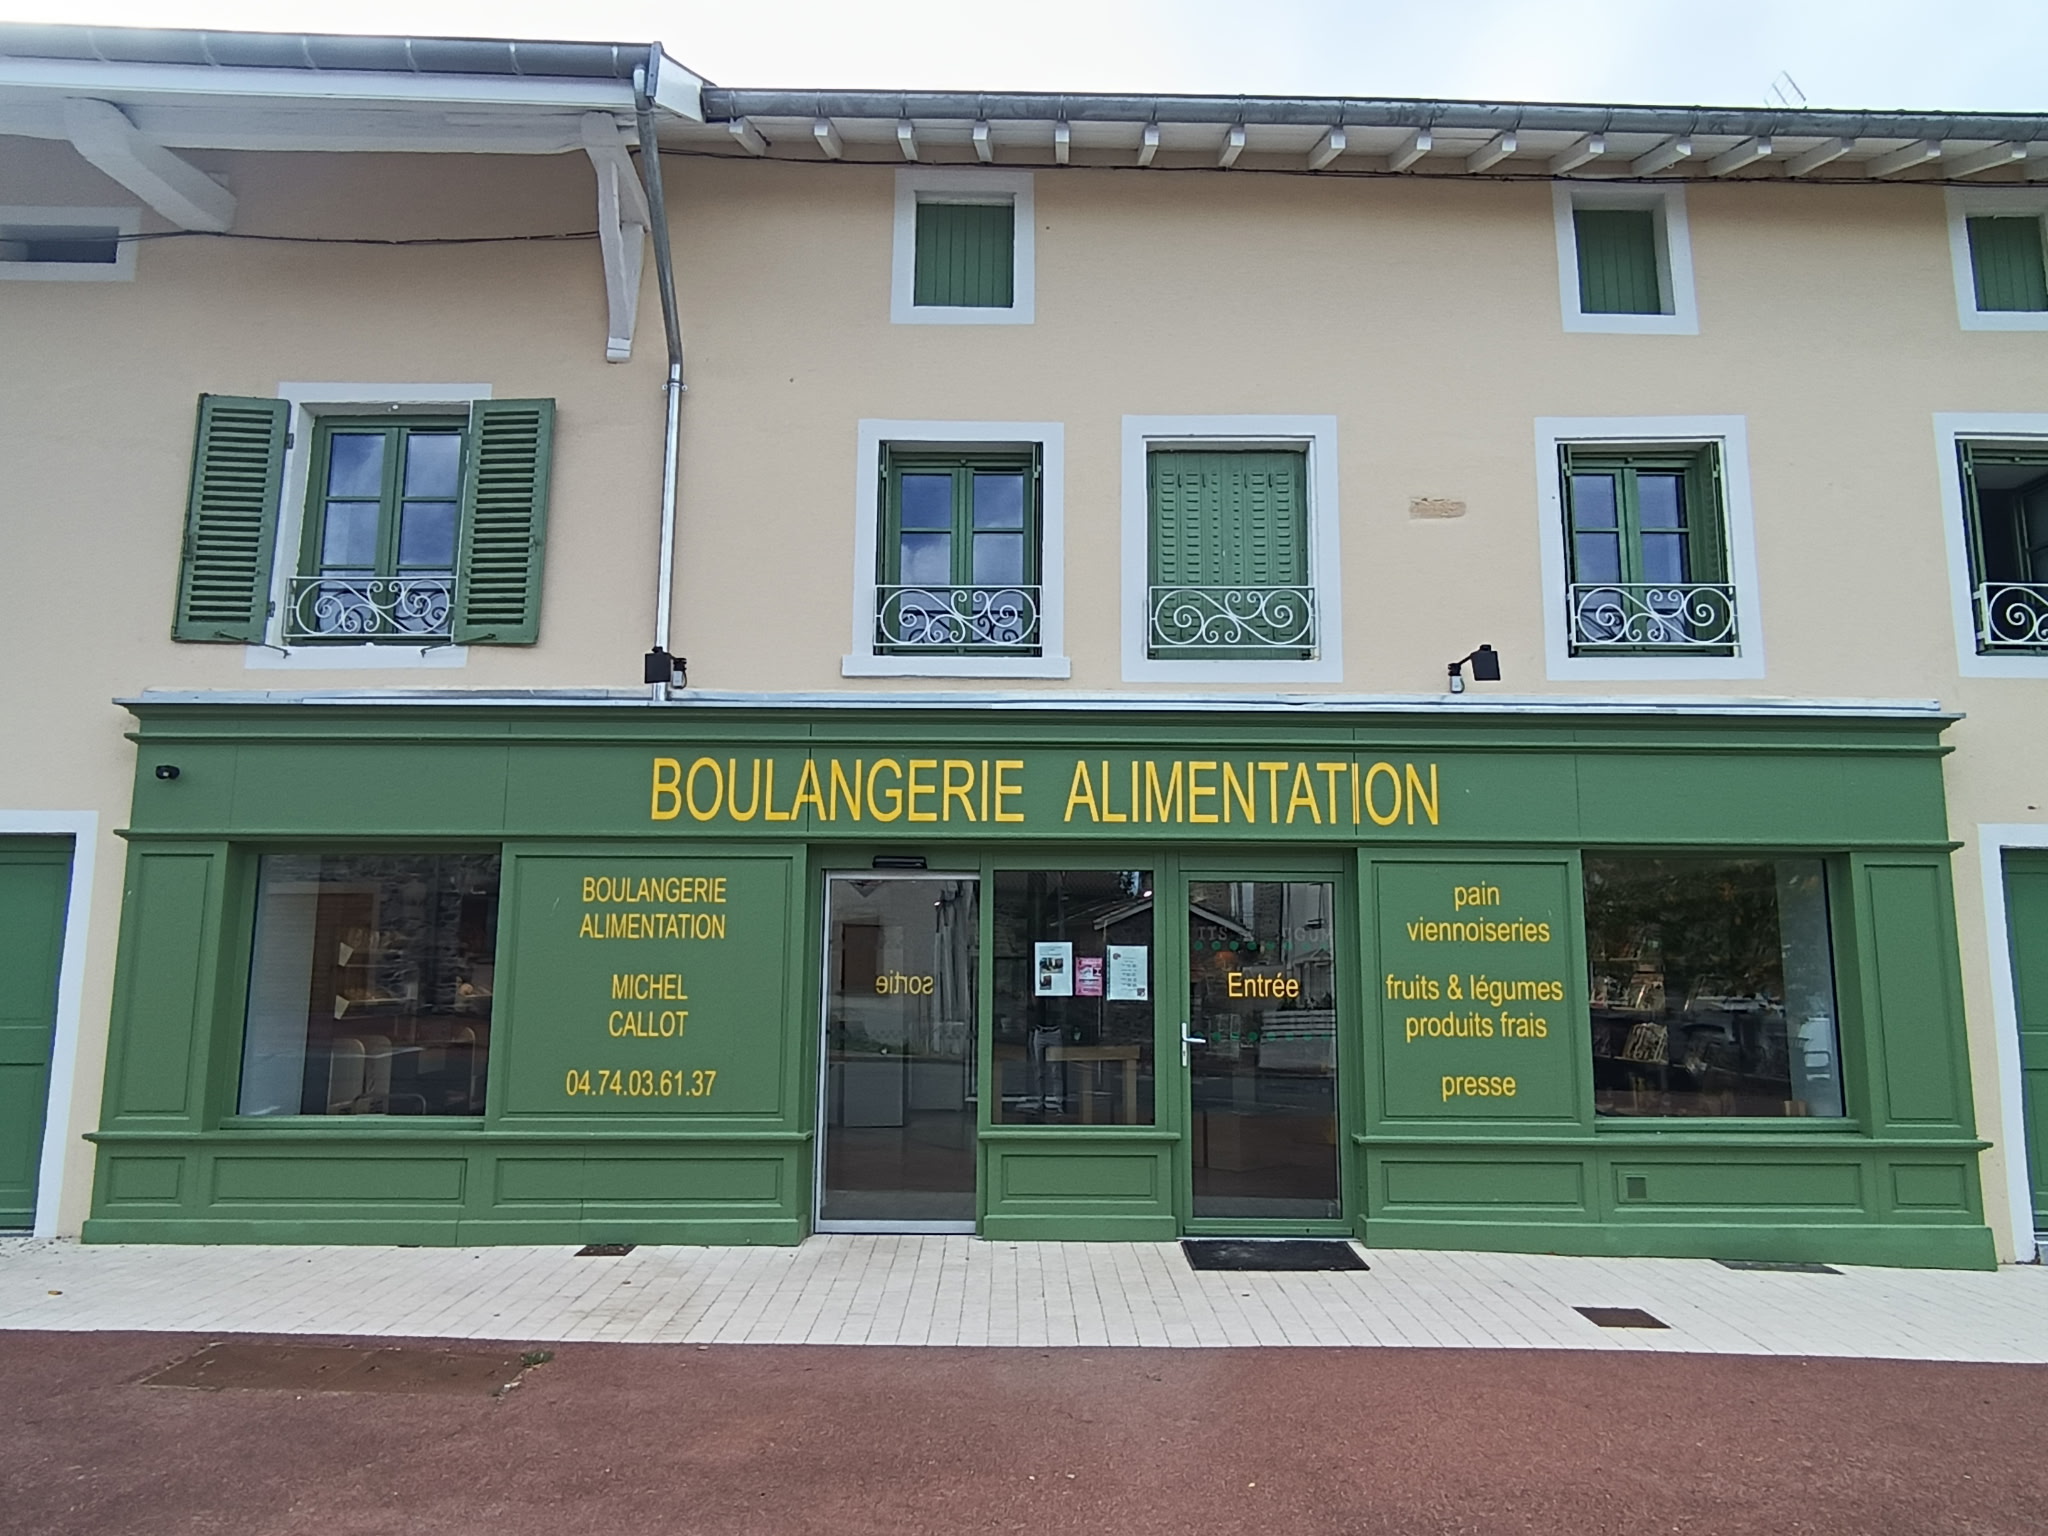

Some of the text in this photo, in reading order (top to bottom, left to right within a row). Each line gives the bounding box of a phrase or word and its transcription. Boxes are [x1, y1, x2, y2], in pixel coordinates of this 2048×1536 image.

[650, 756, 1439, 827] BOULANGERIE ALIMENTATION
[582, 876, 727, 904] BOULANGERIE
[1453, 881, 1501, 911] pain
[579, 913, 726, 940] ALIMENTATION
[1406, 917, 1551, 943] viennoiseries
[611, 973, 688, 1000] MICHEL
[1227, 971, 1300, 999] Entrée
[1385, 973, 1564, 1008] fruits & légumes
[608, 1010, 689, 1038] CALLOT
[1405, 1010, 1548, 1043] produits frais
[565, 1069, 717, 1097] 04.74.03.61.37
[1441, 1074, 1517, 1103] presse
